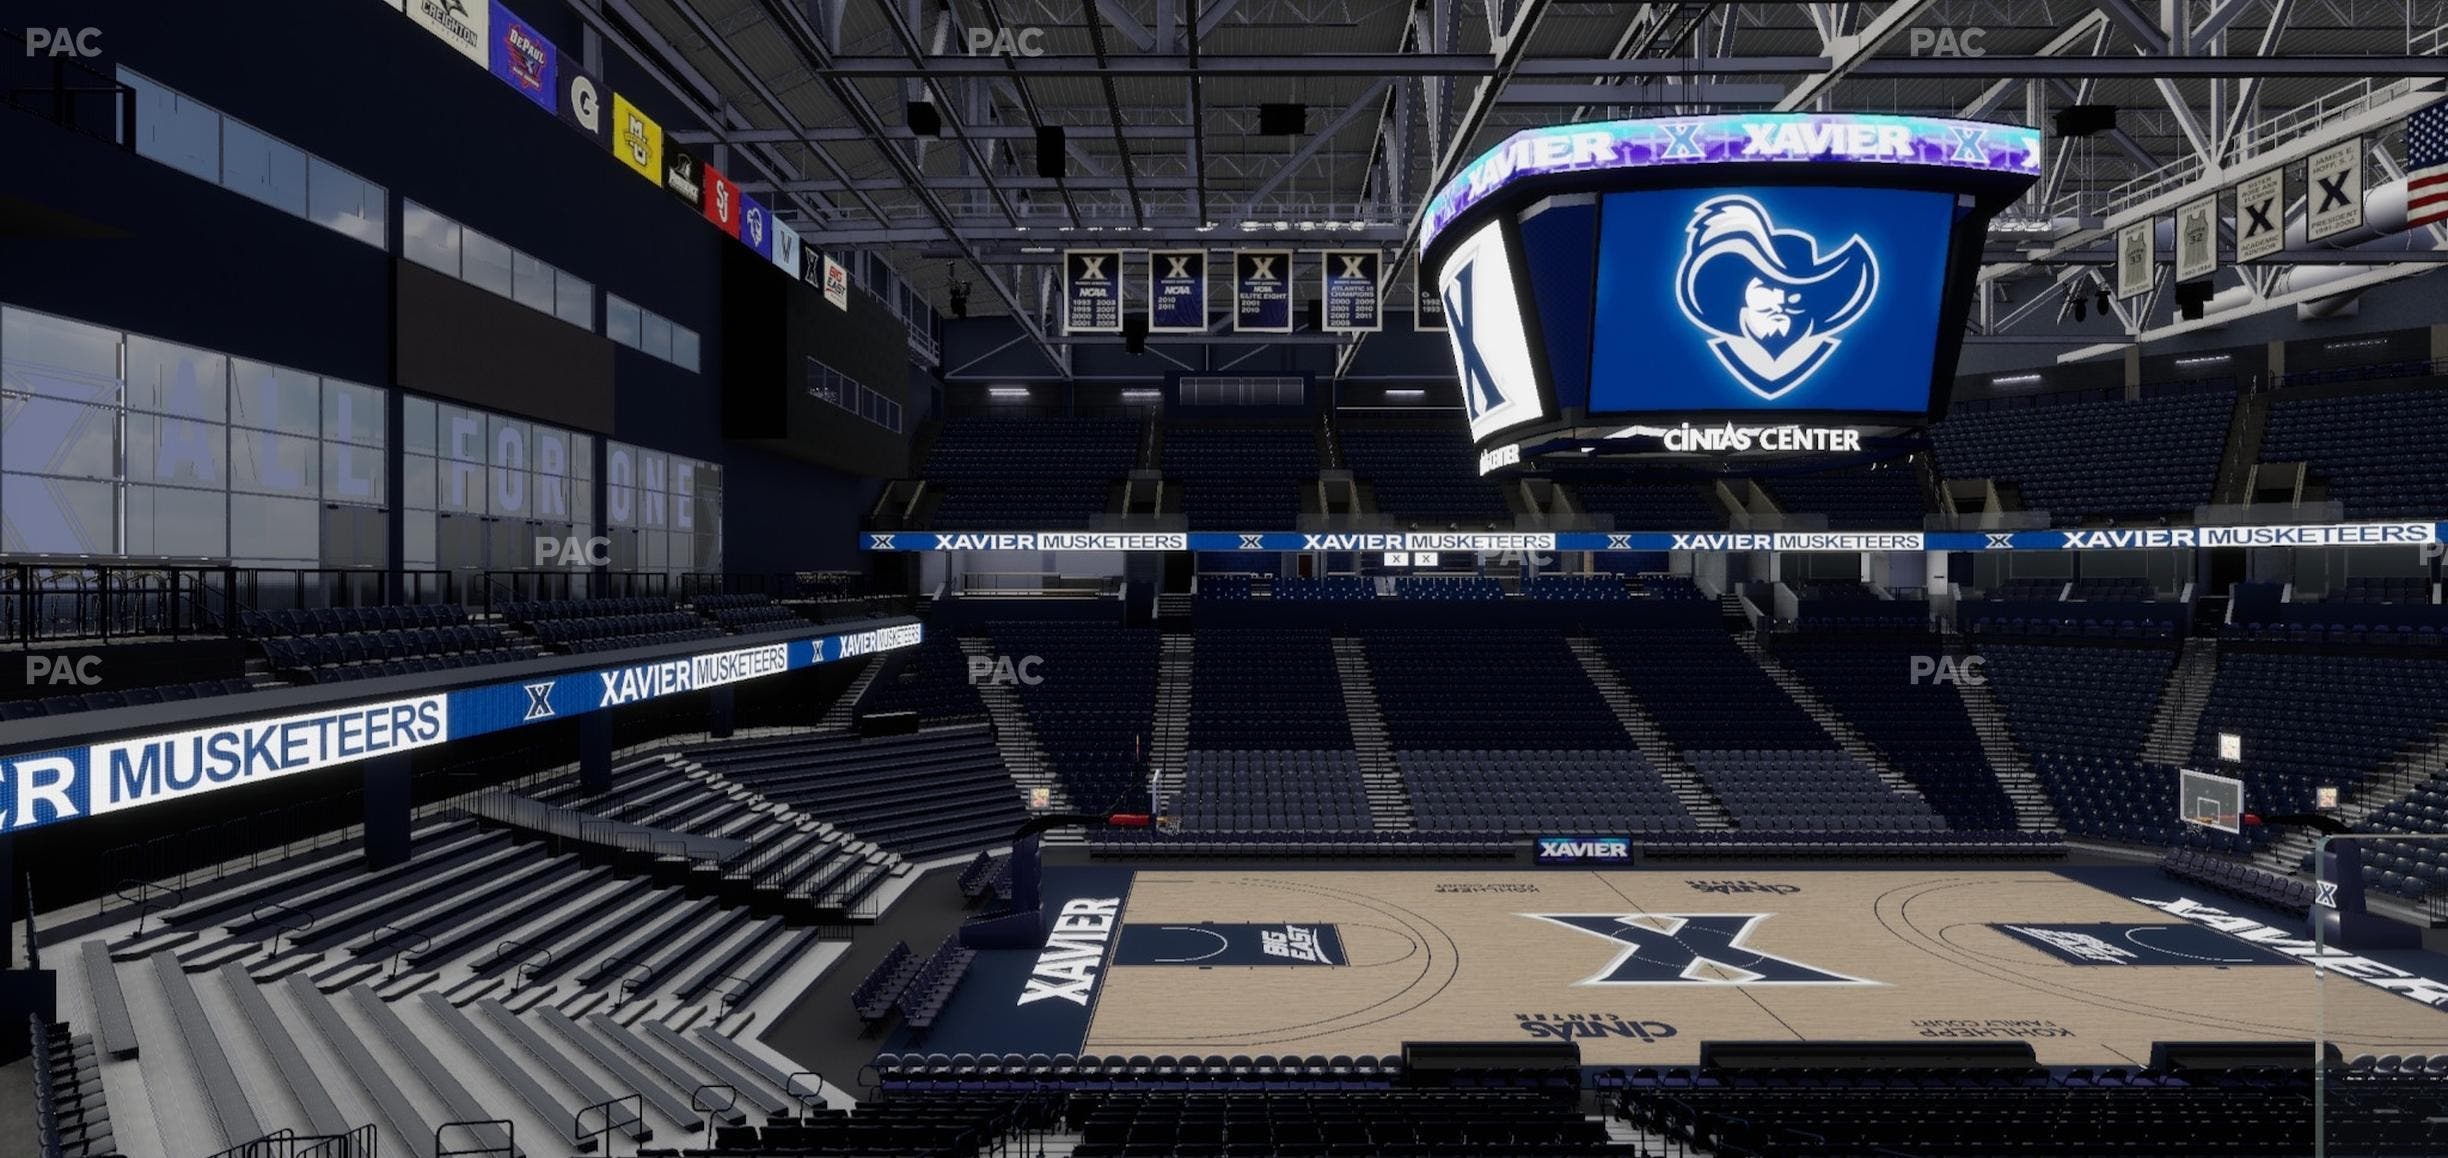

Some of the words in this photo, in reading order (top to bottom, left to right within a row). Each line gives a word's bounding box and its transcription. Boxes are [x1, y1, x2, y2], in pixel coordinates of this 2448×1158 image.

[421, 1, 478, 47] CREIGHTON
[571, 75, 599, 134] G
[1660, 125, 1706, 160] X
[1742, 123, 1915, 157] XAVIER
[1949, 127, 1989, 163] X
[1468, 131, 1618, 200] XAVIER
[2317, 168, 2352, 215] X
[2244, 196, 2275, 239] X
[829, 265, 843, 284] BIG
[1081, 255, 1109, 280] X
[1166, 255, 1192, 279] X
[1250, 256, 1277, 280] X
[1338, 255, 1367, 280] X
[826, 277, 846, 296] EAST
[1443, 245, 1515, 426] X
[157, 356, 371, 496] ALL
[450, 416, 567, 514] FOR
[610, 450, 693, 529] ONE
[1759, 428, 1861, 452] CENTER
[870, 534, 895, 550] X
[933, 533, 1036, 550] XAVIER
[1043, 535, 1183, 549] MUSKETEERS
[1238, 534, 1264, 550] X
[1302, 533, 1402, 550] XAVIER
[1411, 535, 1552, 549] MUSKETEERS
[1607, 534, 1632, 550] X
[1672, 534, 1771, 550] XAVIER
[1779, 535, 1919, 549] MUSKETEERS
[1985, 533, 2014, 549] X
[2062, 529, 2197, 549] XAVIER
[2208, 525, 2428, 545] MUSKETEERS
[839, 631, 877, 659] XAVIER
[600, 659, 692, 707] XAVIER
[698, 646, 787, 686] MUSKETEERS
[523, 681, 556, 721] X
[108, 699, 441, 804] MUSKETEERS
[1539, 840, 1629, 859] XAVIER
[2315, 880, 2338, 908] X
[1016, 897, 1120, 1006] XAVIER
[1261, 930, 1290, 957] BIG
[1286, 925, 1316, 962] EAST
[1512, 912, 1897, 987] X
[1513, 1013, 1620, 1021] CENTER
[1919, 1027, 2077, 1037] KOHLHEPP
